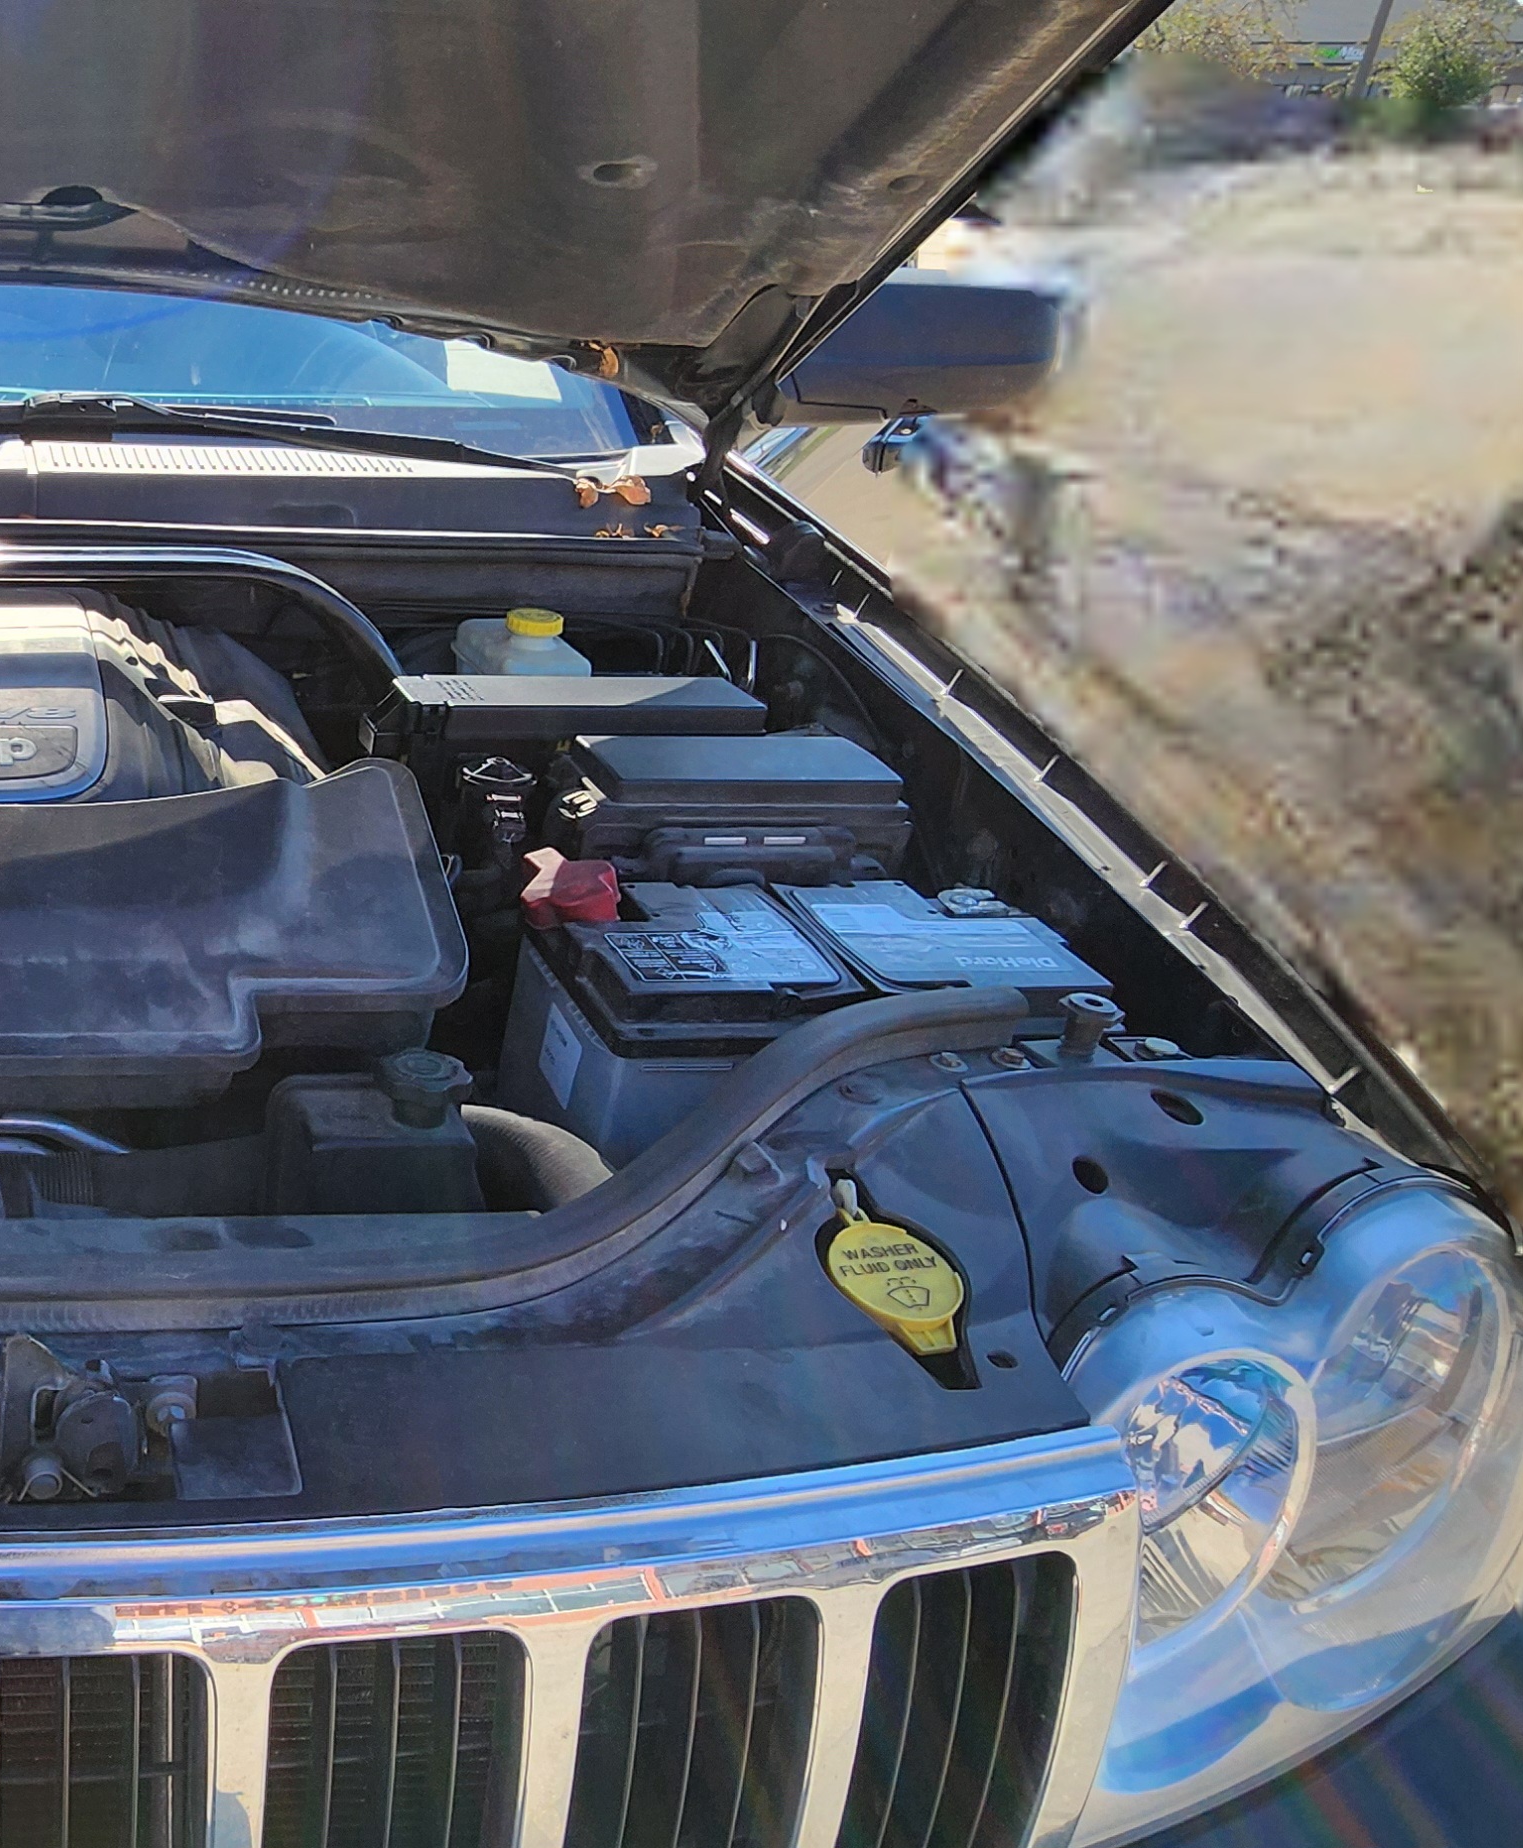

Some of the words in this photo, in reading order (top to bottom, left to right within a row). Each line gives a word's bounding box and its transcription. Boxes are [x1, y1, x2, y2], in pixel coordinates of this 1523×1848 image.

[955, 956, 1059, 968] DieHard
[842, 1243, 919, 1260] WASHER
[839, 1261, 891, 1277] FLUID
[894, 1256, 938, 1271] ONLY
